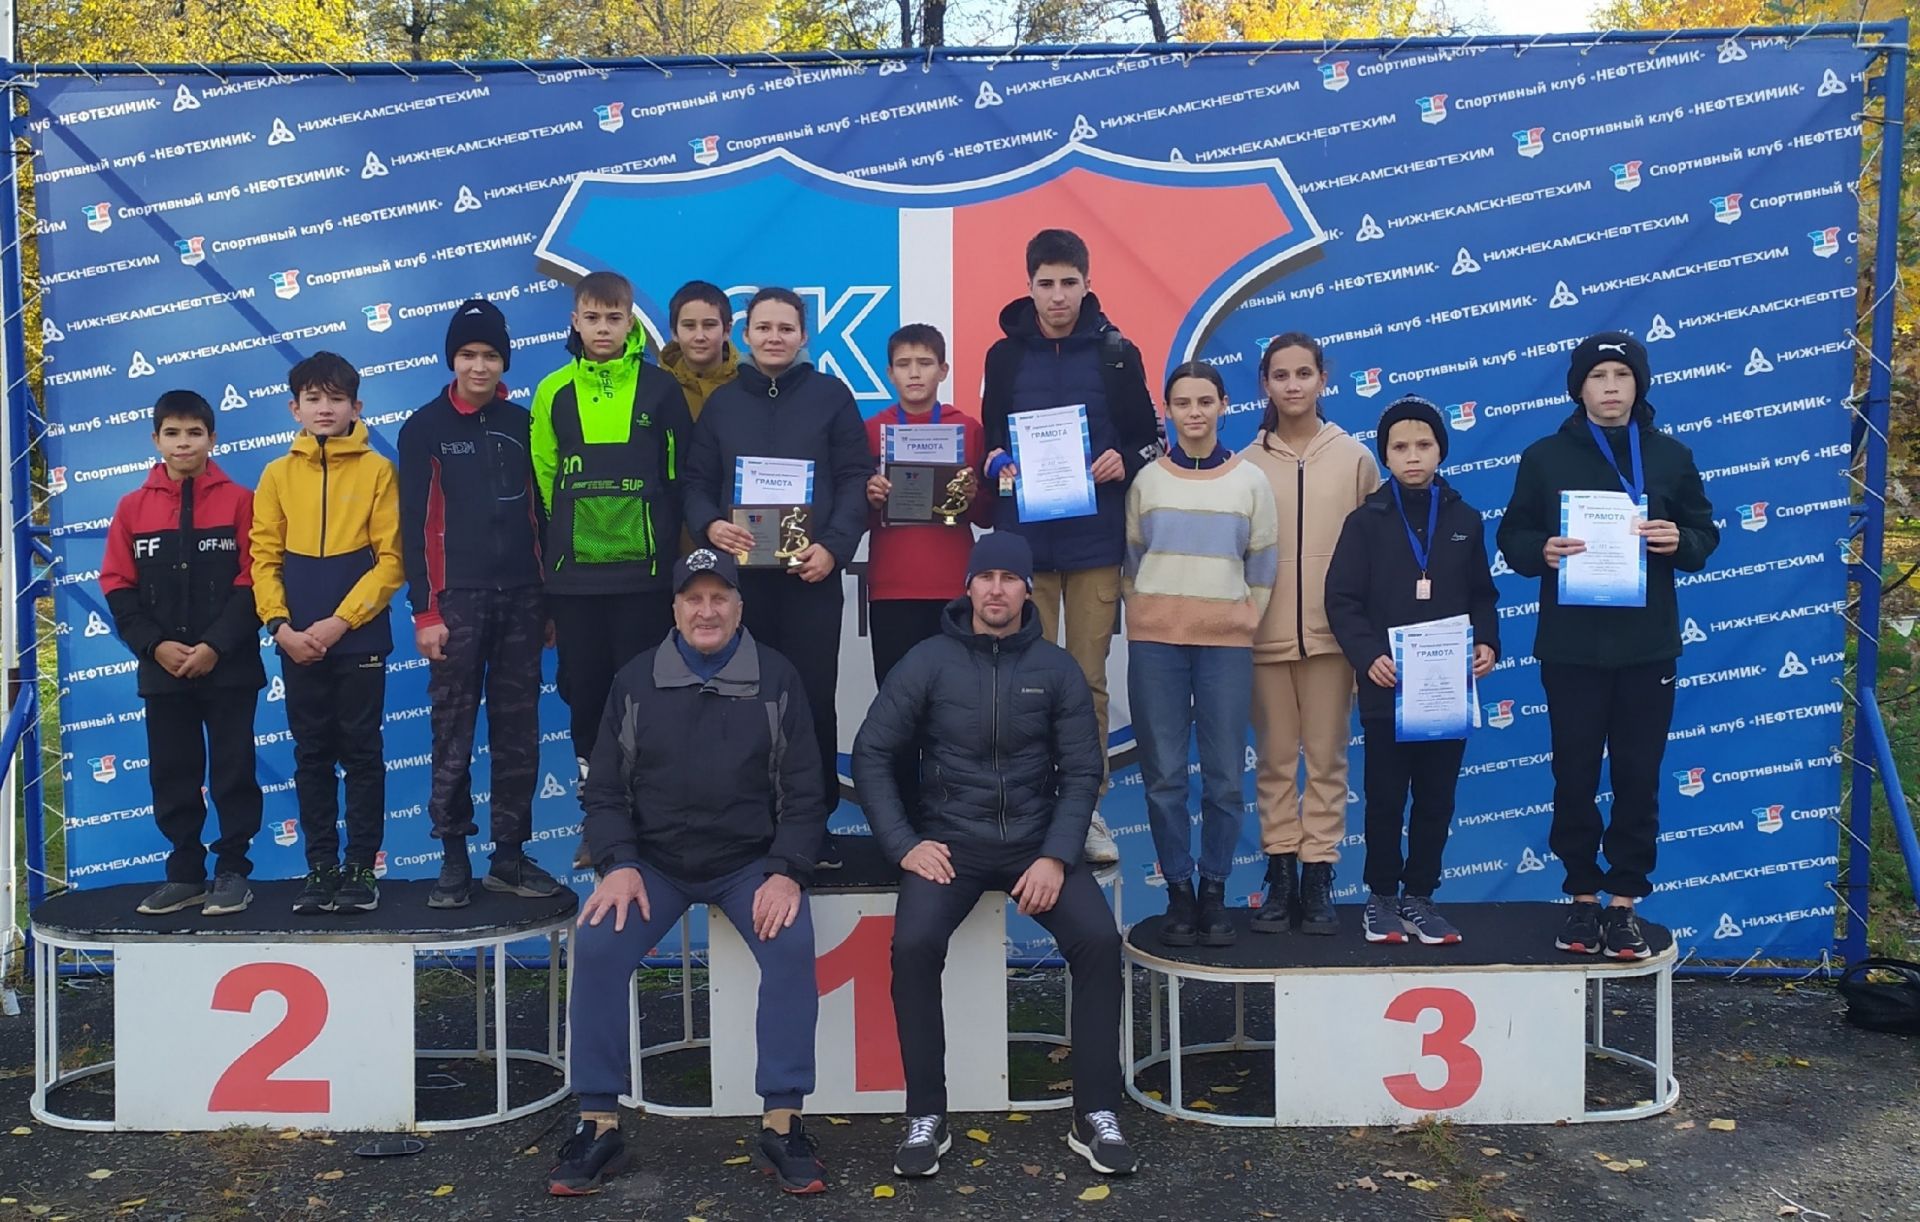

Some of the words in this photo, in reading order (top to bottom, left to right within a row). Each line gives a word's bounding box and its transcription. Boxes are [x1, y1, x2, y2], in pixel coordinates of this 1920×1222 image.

[1551, 74, 1585, 90] клуб
[722, 84, 755, 100] клуб
[1649, 107, 1683, 123] клуб
[817, 117, 850, 133] клуб
[1748, 140, 1783, 157] клуб
[113, 152, 146, 167] клуб
[912, 150, 944, 166] клуб
[208, 186, 240, 201] клуб
[301, 220, 333, 235] клуб
[395, 253, 427, 268] клуб
[487, 286, 519, 301] клуб
[1291, 283, 1324, 299] клуб
[1388, 317, 1421, 332] клуб
[1483, 350, 1516, 365] клуб
[69, 417, 101, 432] клуб
[1677, 417, 1712, 432] клуб
[1031, 430, 1068, 440] ГРАМОТА
[907, 443, 944, 451] ГРАМОТА
[1775, 450, 1810, 466] клуб
[755, 478, 792, 487] ГРАМОТА
[1584, 513, 1625, 521] ГРАМОТА
[1416, 649, 1455, 658] ГРАМОТА
[1711, 718, 1745, 733] клуб
[1808, 749, 1845, 767] клуб
[391, 805, 421, 818] клуб
[208, 962, 330, 1113] 2
[1382, 987, 1483, 1110] 3
